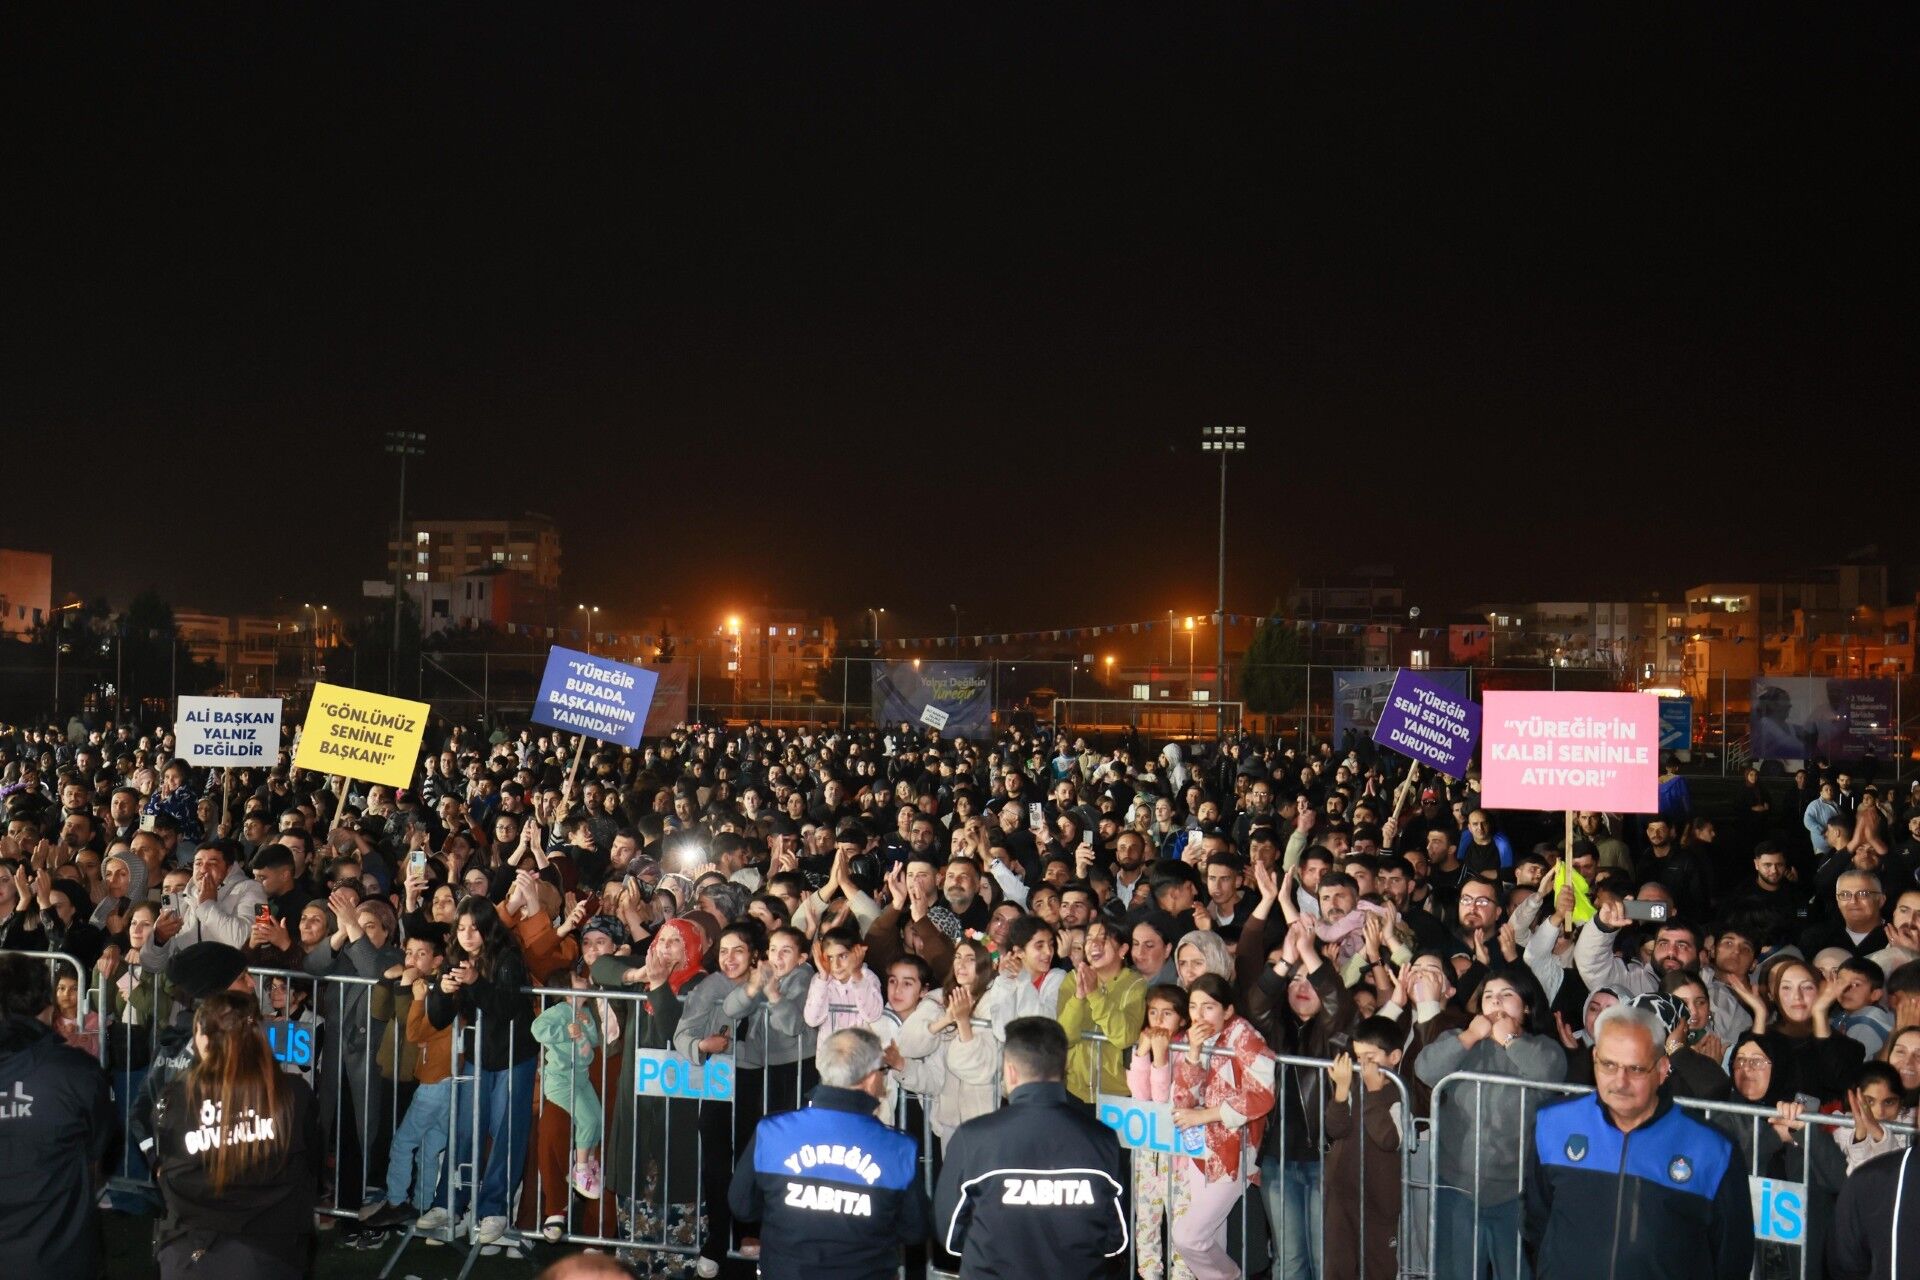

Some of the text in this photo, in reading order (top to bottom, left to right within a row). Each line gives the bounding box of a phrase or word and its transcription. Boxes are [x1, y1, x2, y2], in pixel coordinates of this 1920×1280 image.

[568, 661, 635, 690] “YÜREĞİR
[565, 677, 626, 706] BURADA,
[1413, 687, 1466, 722] “YÜREĞİR
[185, 708, 275, 727] ALİ BAŞKAN
[320, 702, 416, 733] “GÖNLÜMÜZ
[549, 690, 636, 724] BAŞKANININ
[552, 707, 626, 736] YANINDA!”
[1394, 696, 1470, 743] SENİ SEVİYOR,
[203, 727, 257, 740] YALNIZ
[330, 723, 394, 748] SENİNLE
[1404, 716, 1453, 750] YANINDA
[1504, 715, 1637, 740] “YÜREĞİR’İN
[193, 741, 263, 756] DEĞİLDİR
[319, 740, 395, 766] BAŞKAN!”
[1390, 728, 1456, 764] DURUYOR!”
[1491, 740, 1649, 764] KALBİ SENİNLE
[1521, 767, 1617, 787] ATIYOR!”
[784, 1182, 872, 1217] ZABITA
[1002, 1179, 1095, 1206] ZABITA
